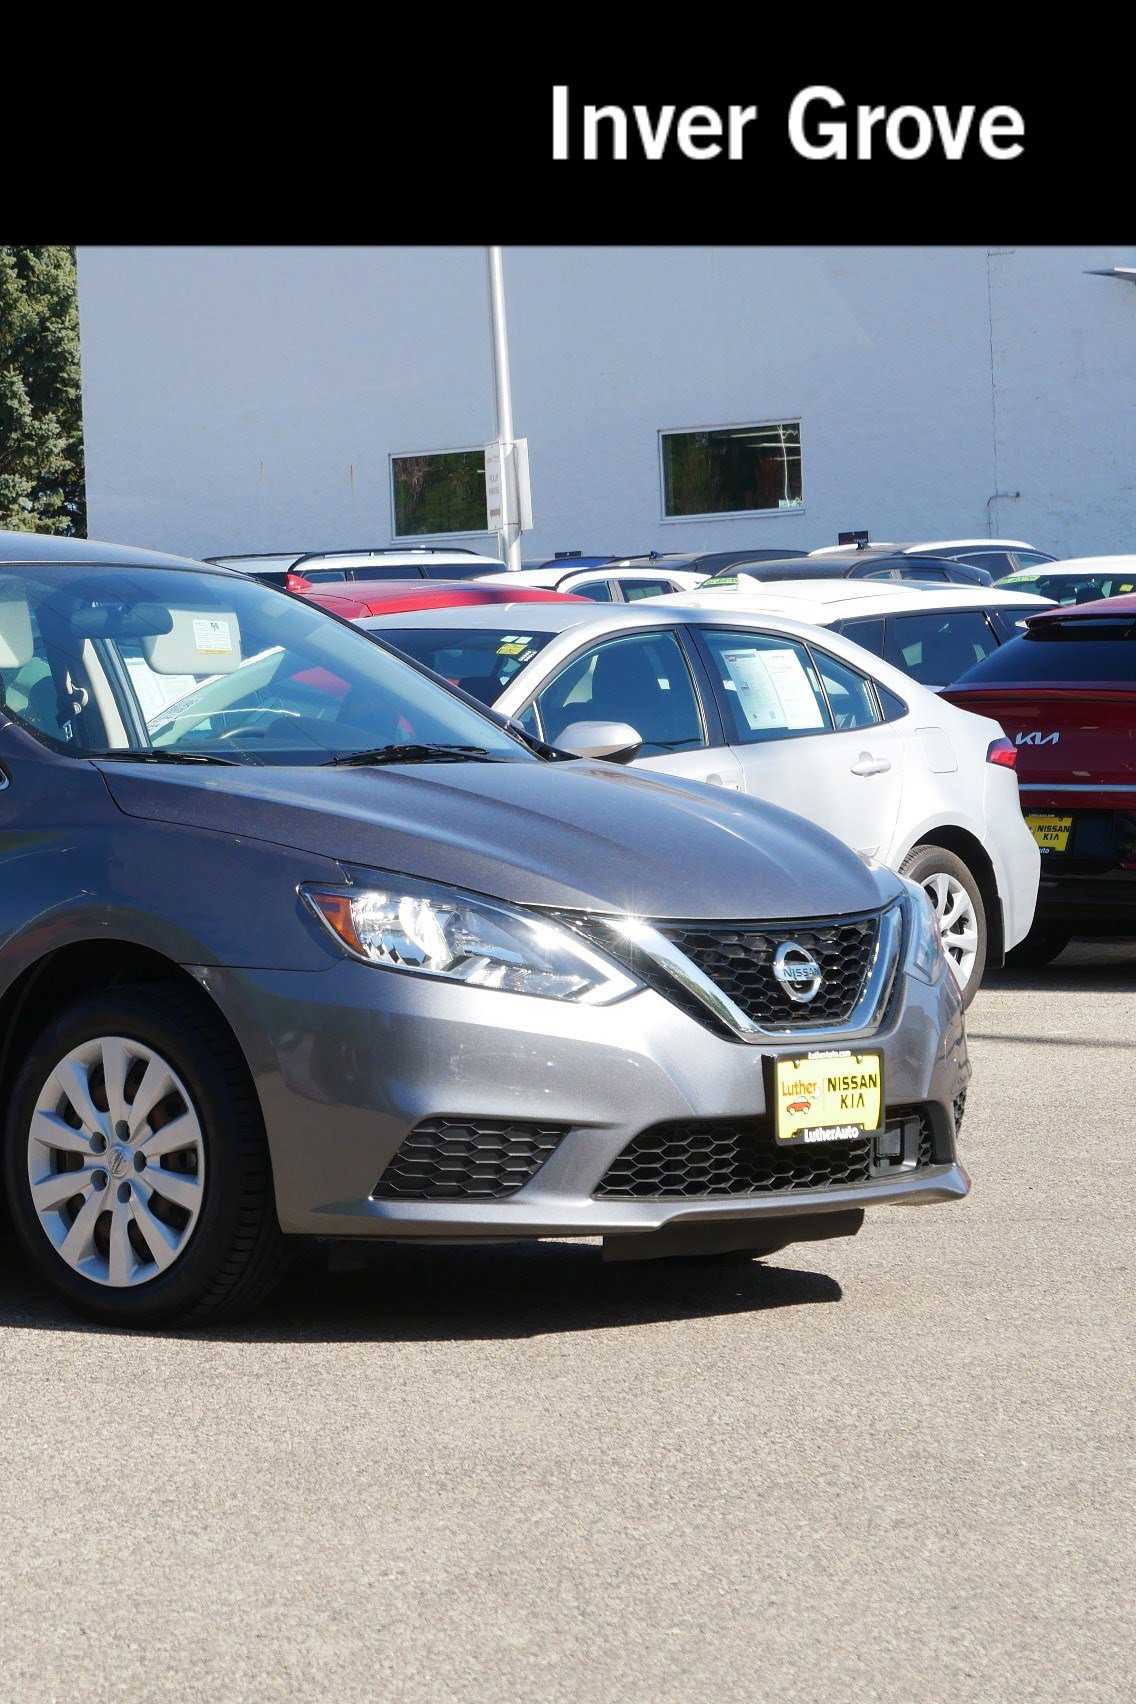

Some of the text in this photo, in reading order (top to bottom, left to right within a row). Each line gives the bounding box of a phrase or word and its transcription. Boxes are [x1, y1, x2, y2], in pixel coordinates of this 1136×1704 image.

[1016, 731, 1060, 745] KIA
[1037, 825, 1071, 833] NISSAN
[1042, 833, 1059, 841] KIA
[783, 967, 819, 978] NISSAN
[781, 1073, 878, 1096] Luther NISSAN
[840, 1092, 865, 1110] KIA
[804, 1126, 859, 1142] LutherAuto
